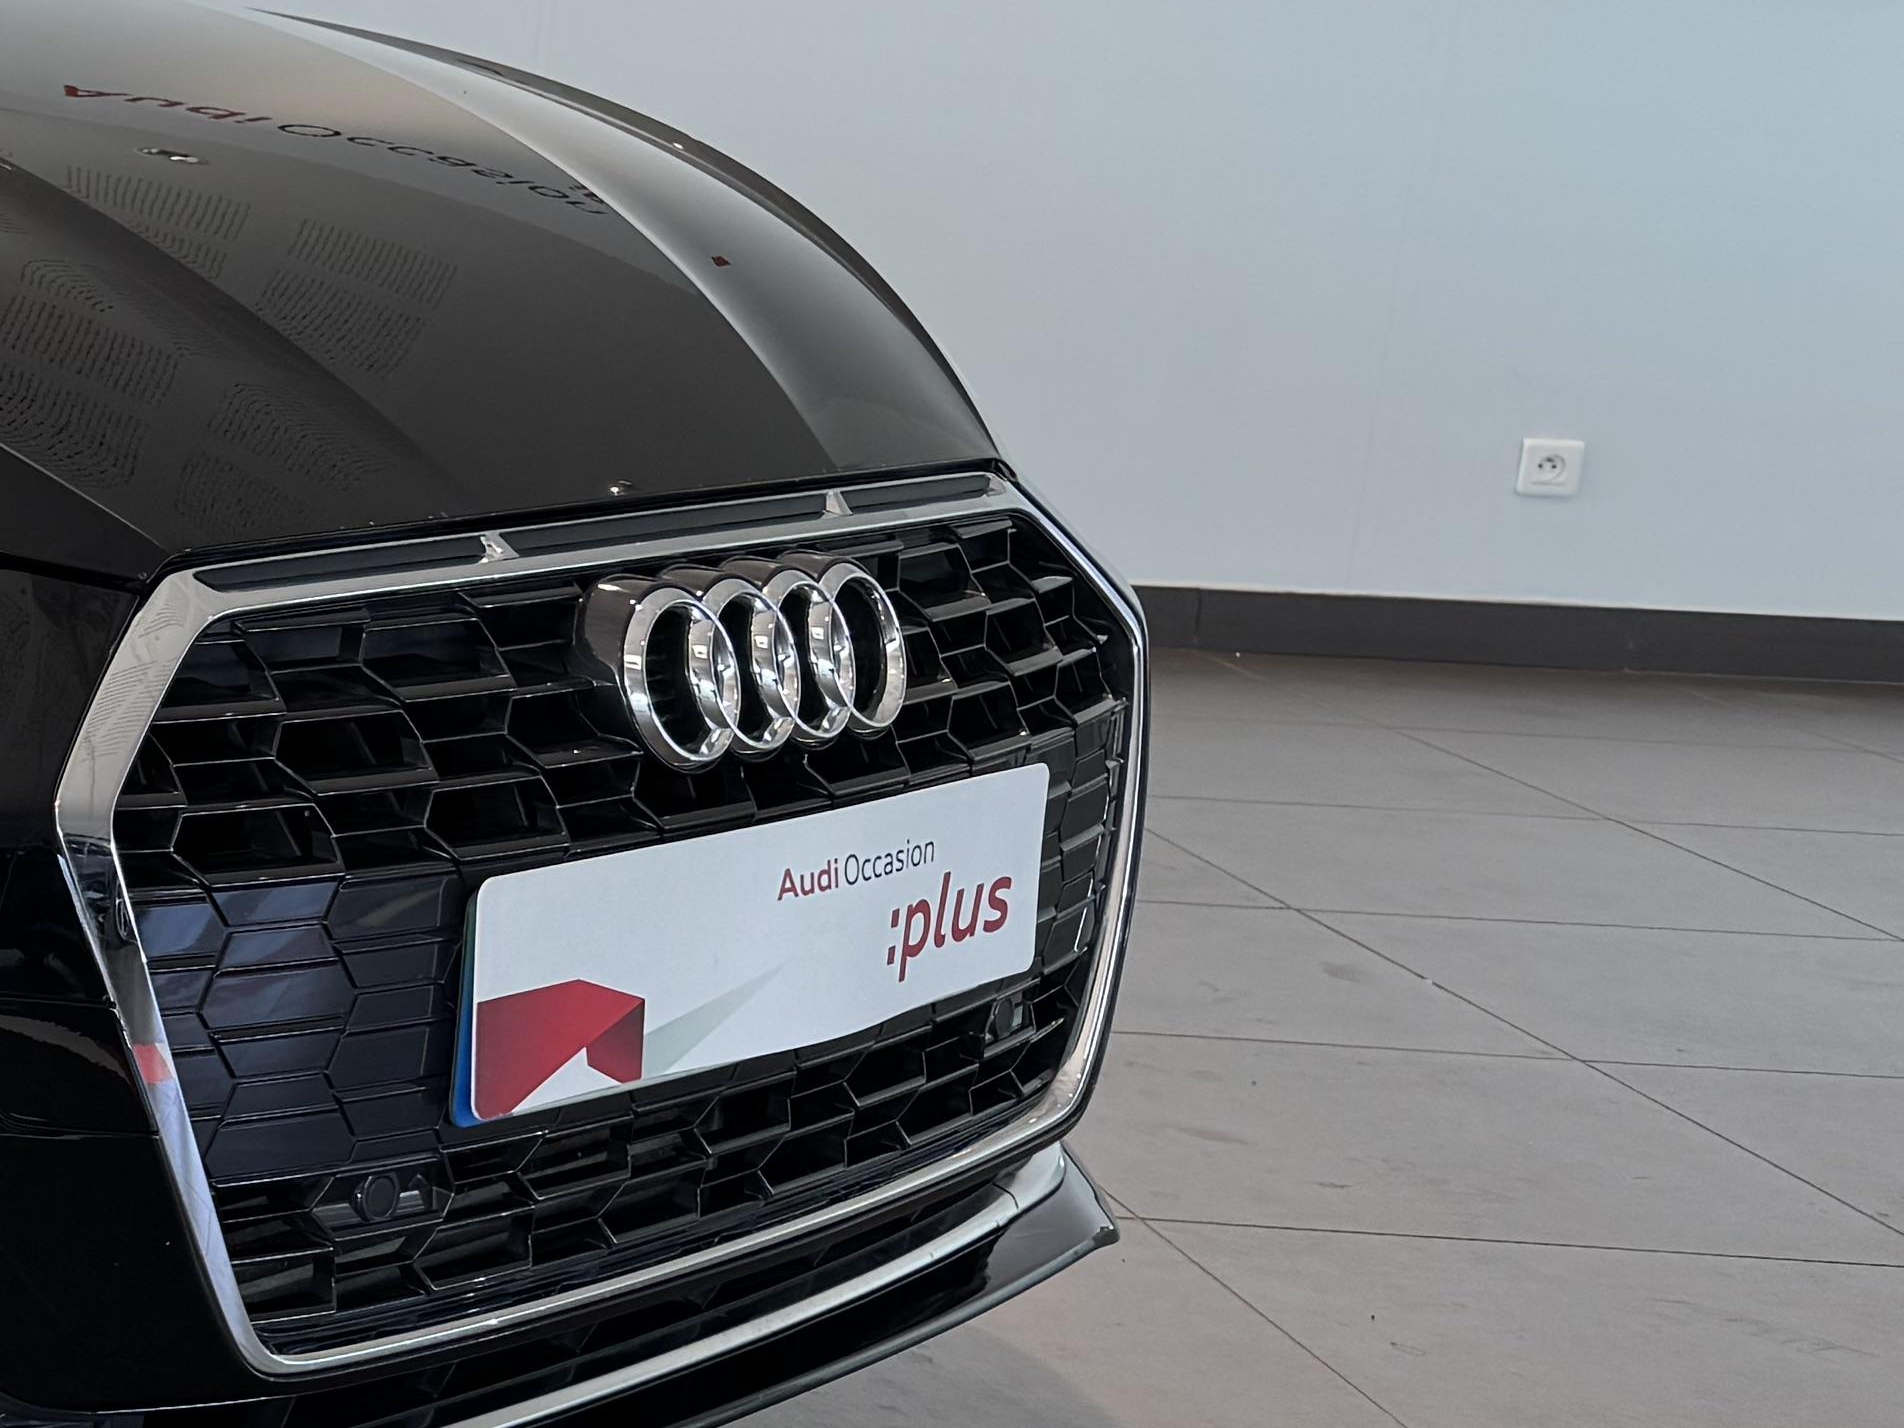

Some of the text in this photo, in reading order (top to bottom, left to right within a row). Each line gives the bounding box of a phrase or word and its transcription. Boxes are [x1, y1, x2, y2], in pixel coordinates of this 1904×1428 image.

[777, 837, 936, 902] Audi Occasion
[885, 871, 1013, 983] :plus
